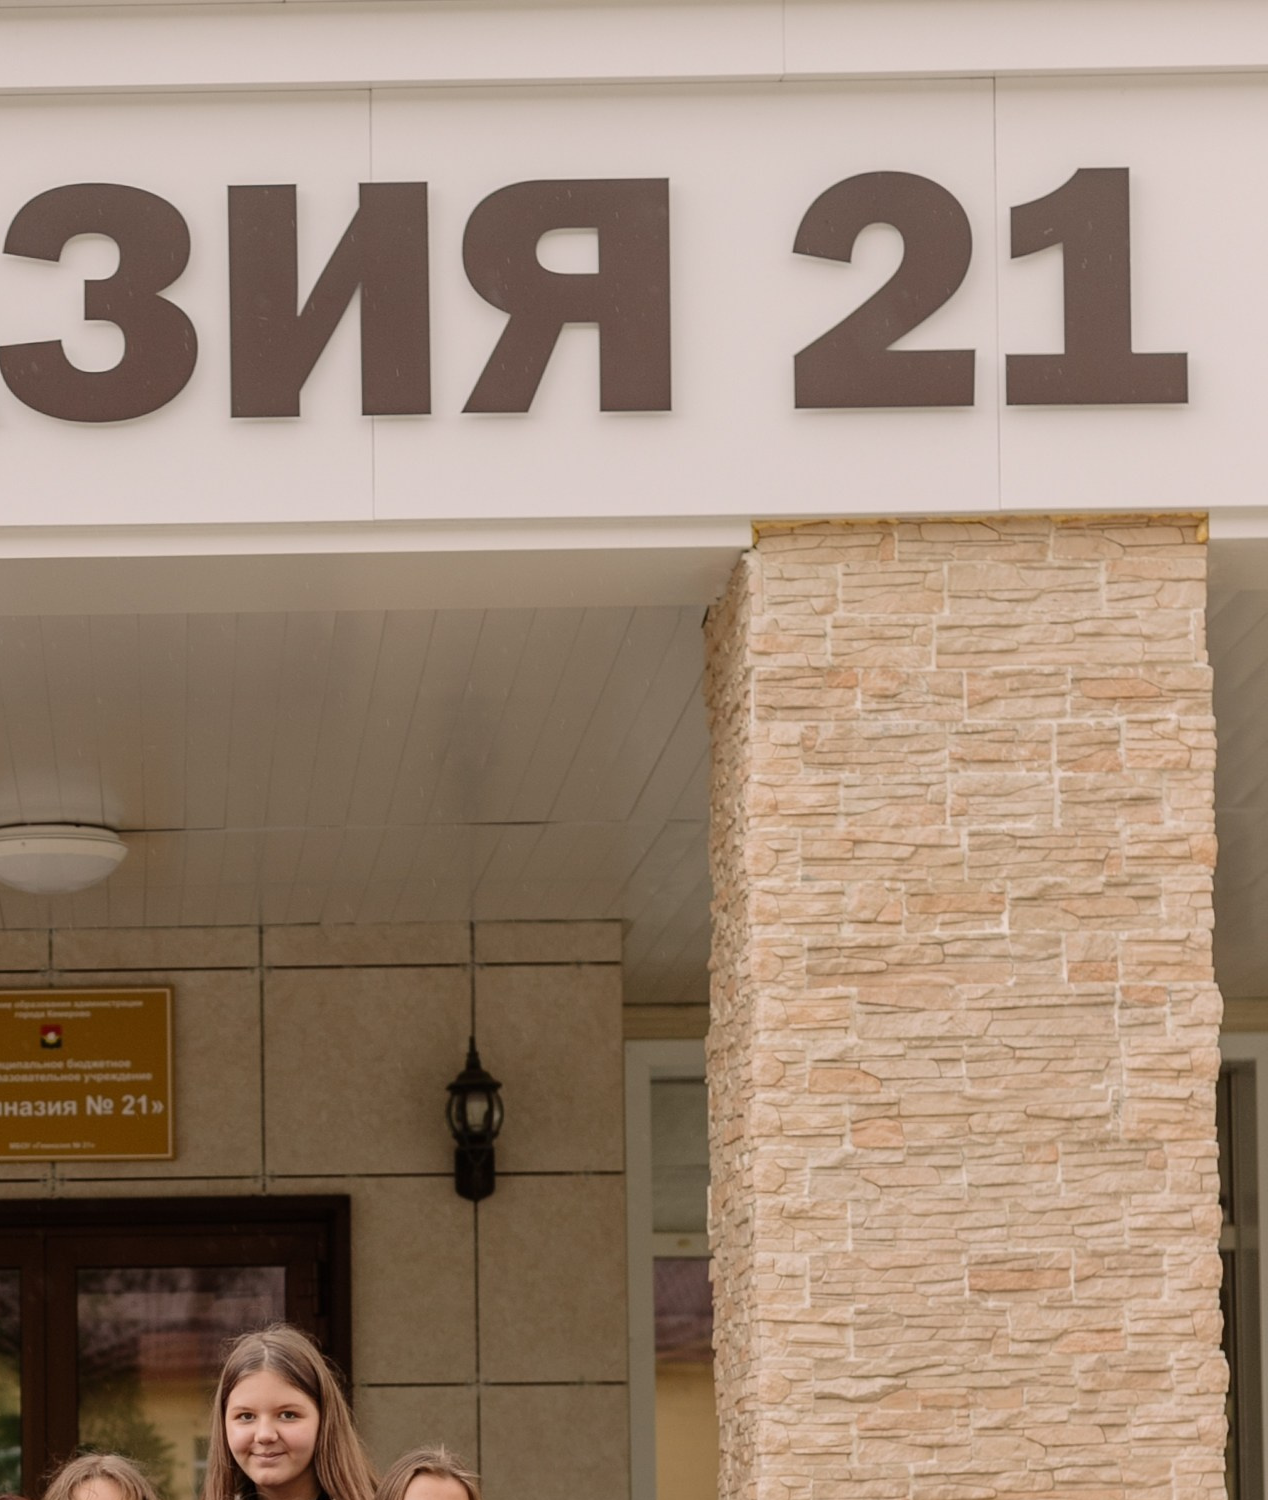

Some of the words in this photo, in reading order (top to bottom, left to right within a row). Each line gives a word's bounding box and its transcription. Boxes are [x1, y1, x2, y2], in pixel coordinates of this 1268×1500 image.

[793, 168, 1188, 409] 21
[66, 1058, 131, 1070] бюджетное
[83, 1071, 153, 1083] учреждение
[86, 1094, 114, 1116] №
[121, 1094, 164, 1116] 21»
